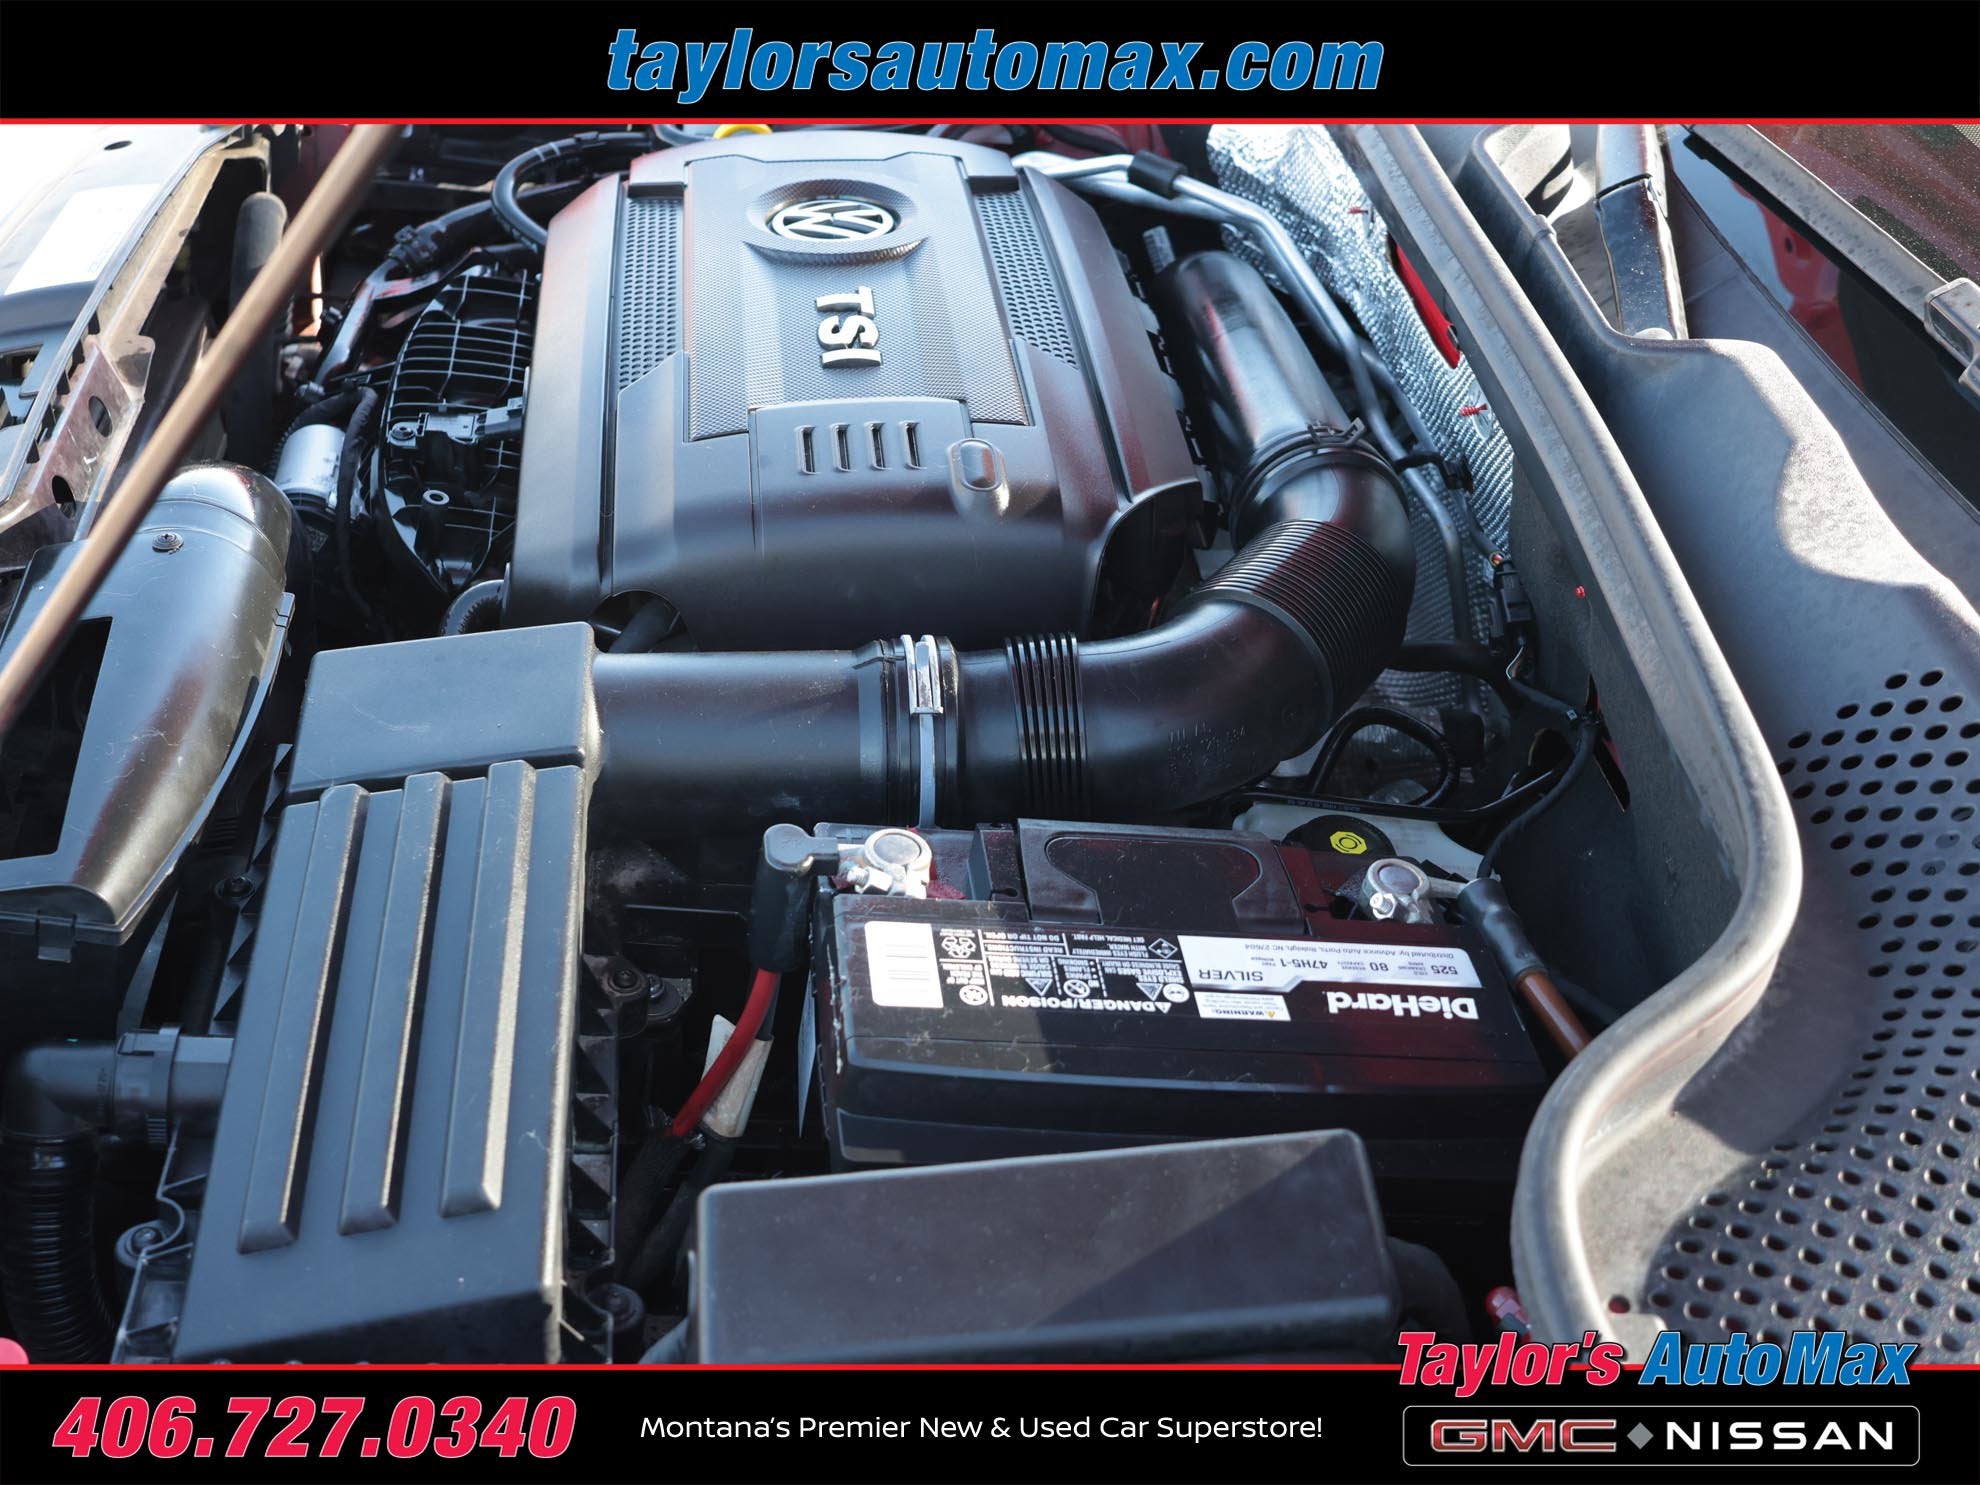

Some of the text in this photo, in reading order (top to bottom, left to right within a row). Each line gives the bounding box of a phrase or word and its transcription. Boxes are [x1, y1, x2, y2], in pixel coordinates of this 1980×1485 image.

[815, 285, 882, 368] TSI
[1049, 934, 1060, 942] DO
[1043, 946, 1063, 954] READ
[1411, 950, 1454, 959] Distributed
[1280, 958, 1328, 969] 47H5-1
[1369, 962, 1389, 971] 80
[1199, 969, 1264, 981] SILVER
[1431, 965, 1458, 975] 525
[1001, 995, 1156, 1012] DANGER/POISON
[1326, 991, 1479, 1019] DieHard
